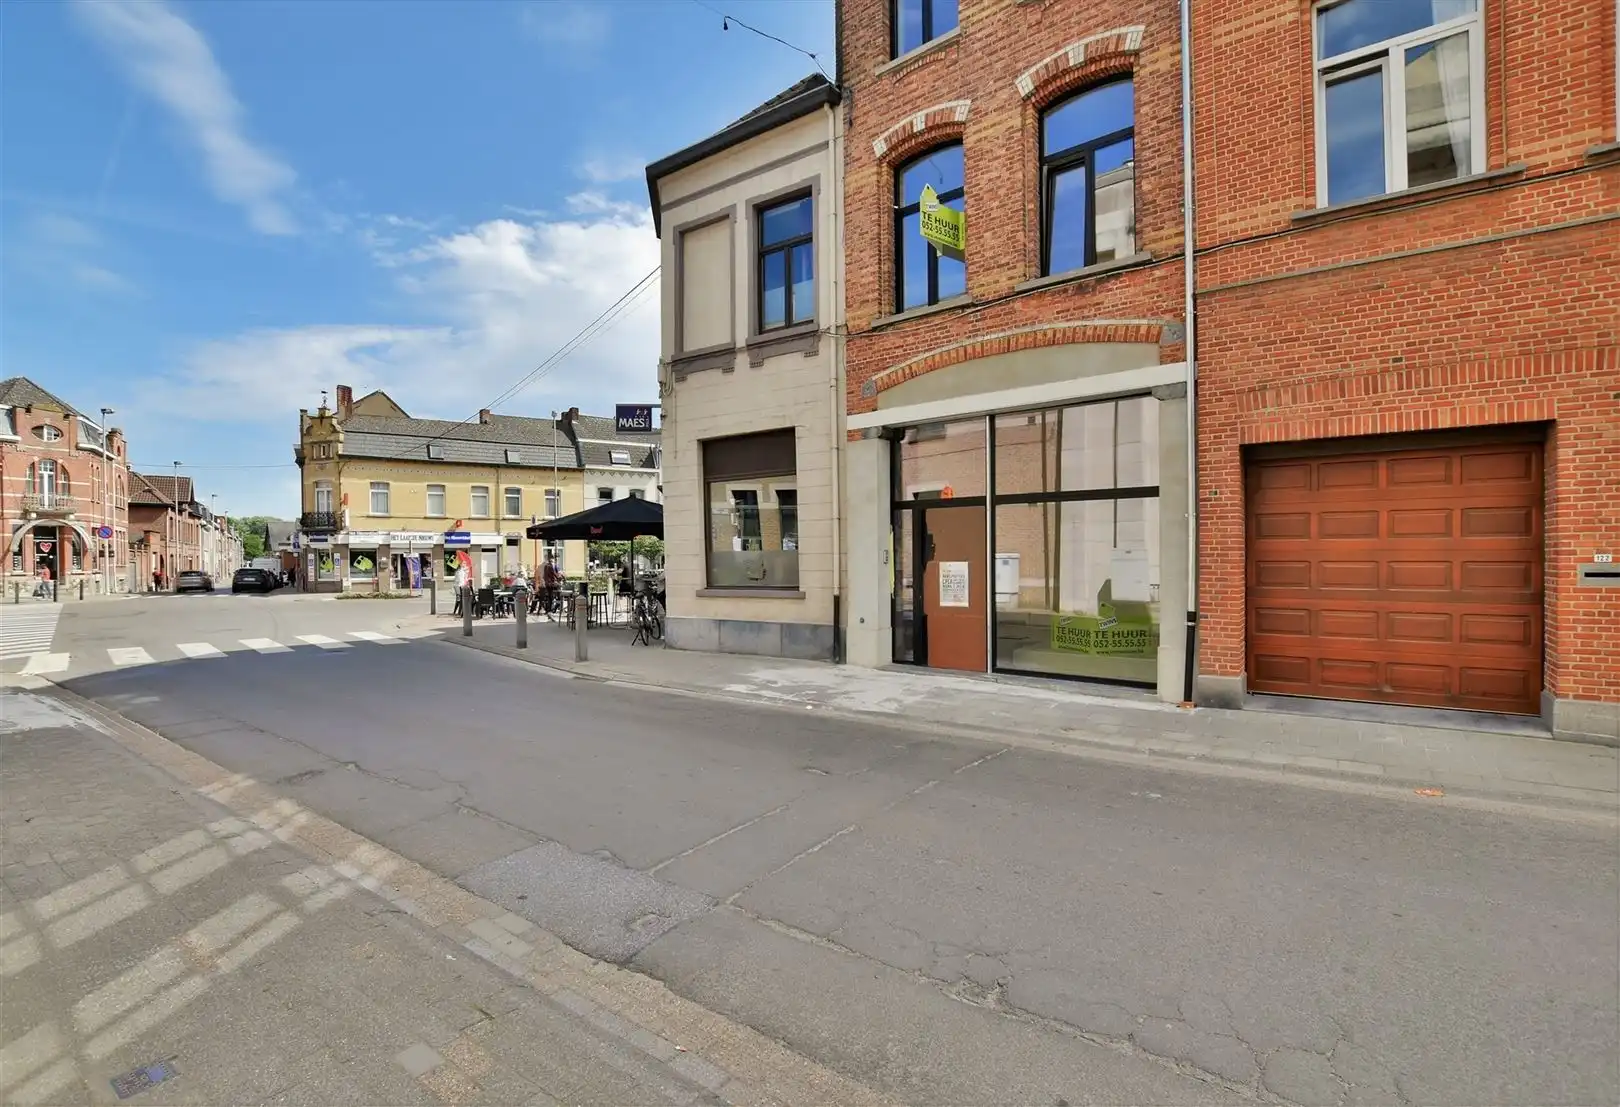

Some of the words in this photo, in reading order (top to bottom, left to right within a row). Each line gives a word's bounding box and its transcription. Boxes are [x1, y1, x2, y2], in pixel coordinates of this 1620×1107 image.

[921, 210, 933, 222] TE
[935, 217, 960, 233] HUUR
[921, 220, 960, 242] 052-55.55.55
[618, 418, 645, 428] MAES
[1056, 626, 1066, 635] TE
[1067, 627, 1091, 639] HUUR
[1094, 630, 1108, 639] TE
[1111, 629, 1147, 639] HUUR
[1093, 639, 1146, 648] 052-55.55.55
